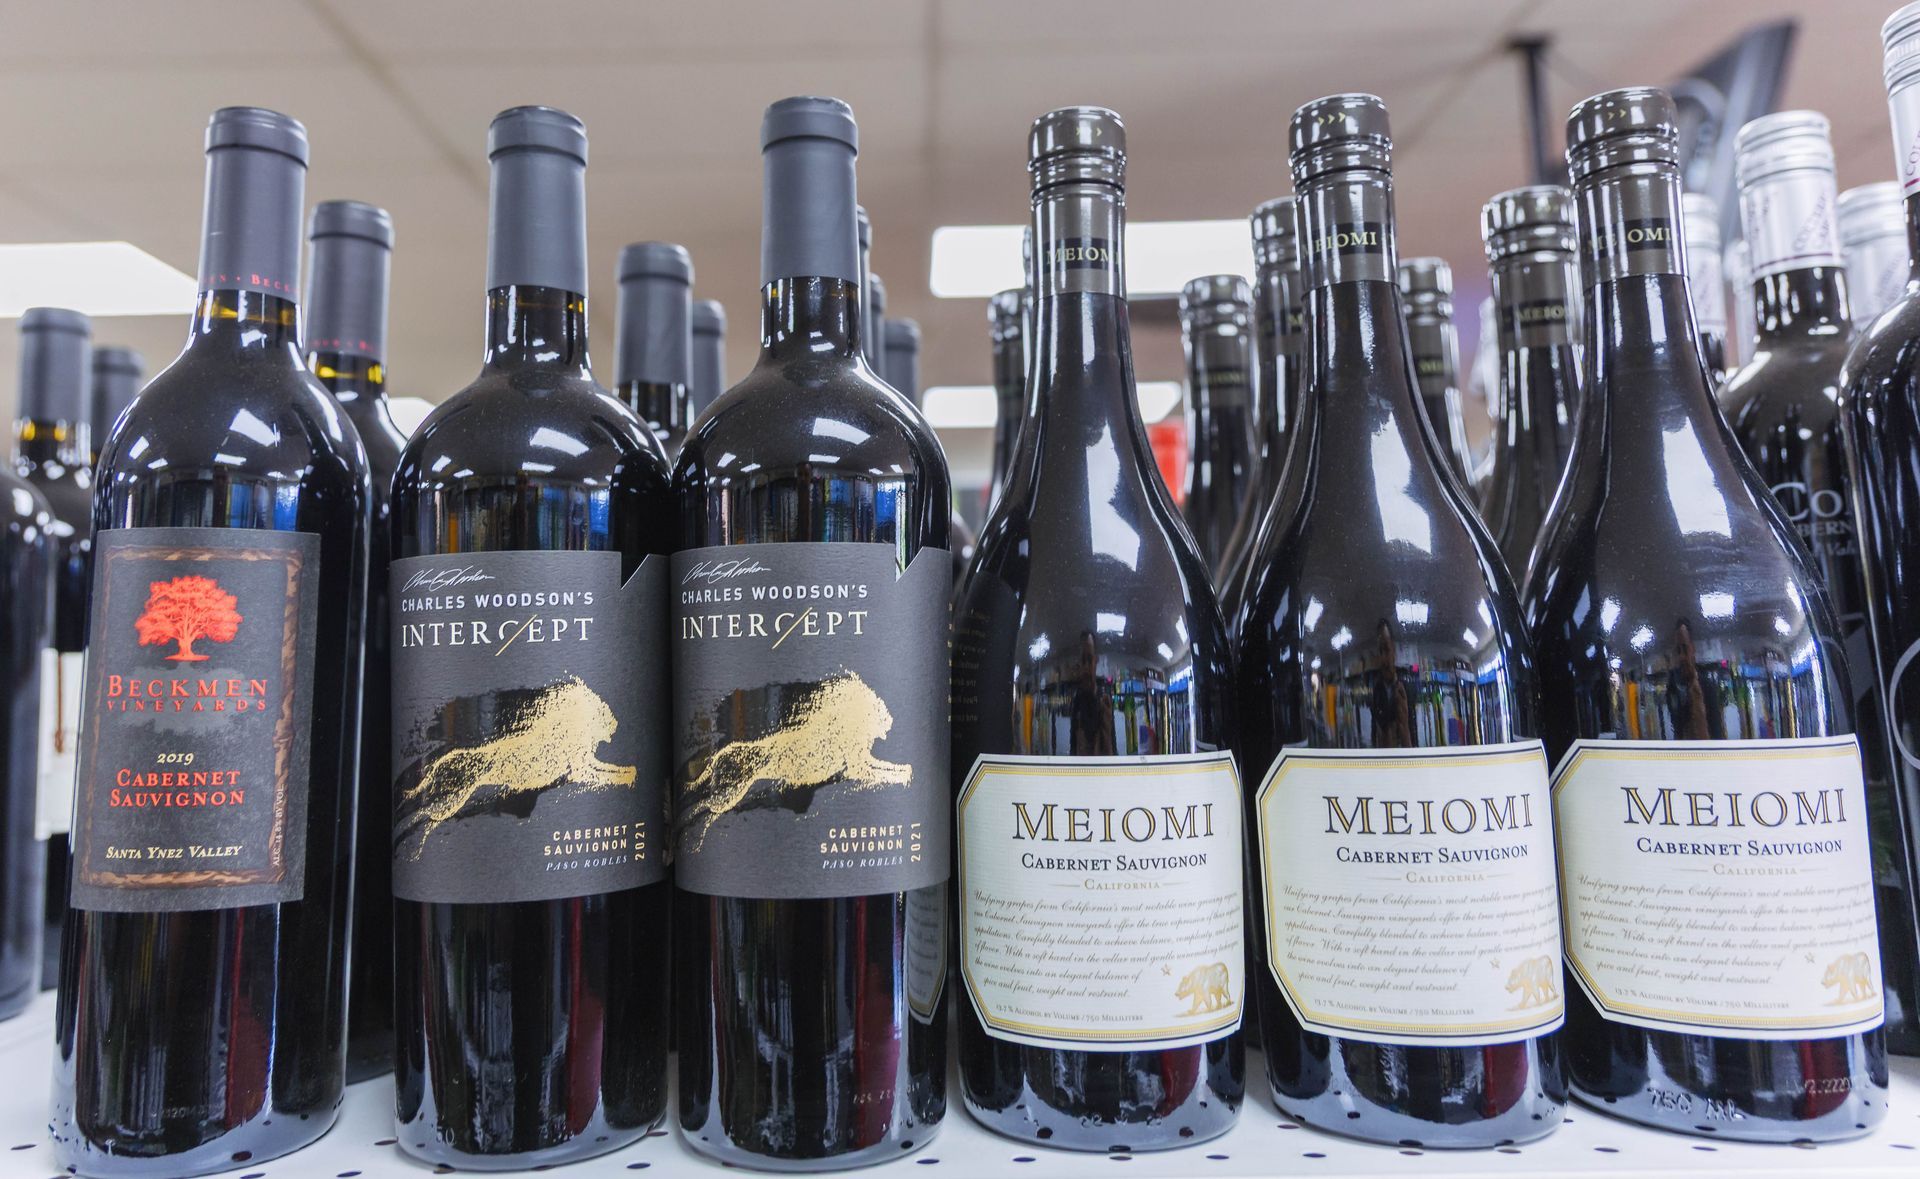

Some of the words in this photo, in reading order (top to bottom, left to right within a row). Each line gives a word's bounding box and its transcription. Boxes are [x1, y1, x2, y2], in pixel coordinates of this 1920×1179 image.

[402, 596, 465, 612] CHARLES
[475, 591, 594, 608] WOODSON'S
[682, 587, 743, 604] CHARLES
[752, 584, 868, 599] WOODSON'S
[402, 614, 594, 651] INTERCEPT
[682, 609, 868, 643] INTERCEPT
[107, 674, 268, 698] BECKMEN
[107, 700, 267, 712] VINEYARDS
[157, 752, 194, 765] 2019
[117, 768, 241, 788] CABERNET
[110, 788, 245, 808] SAUVIGNON
[1322, 793, 1533, 836] MEIOMI
[1621, 787, 1847, 828] MEIOMI
[1012, 802, 1214, 843] MEIOMI
[553, 825, 628, 842] CABERNET
[829, 825, 903, 839] CABERNET
[544, 838, 628, 857] SAUVIGNON
[635, 822, 646, 861] 2021
[820, 838, 903, 854] SAUVIGNON
[910, 822, 921, 862] 2021
[1637, 837, 1741, 857] CABERNET
[1748, 839, 1843, 857] SAUVIGNON
[105, 846, 142, 860] SANTA
[148, 846, 183, 860] YNEZ
[188, 845, 244, 859] VALLEY
[1337, 847, 1433, 865] CABERNET
[1439, 844, 1528, 864] SAUVIGNON
[546, 858, 579, 872] PASO
[584, 855, 628, 869] ROBLES
[822, 858, 855, 870] PASO
[860, 855, 904, 869] ROBLES
[1022, 852, 1111, 872] CABERNET
[1116, 852, 1207, 872] SAUVIGNON
[1713, 864, 1797, 876] CALIFORNIA
[1084, 878, 1160, 890] CALIFORNIA
[1406, 871, 1484, 883] CALIFORNIA
[1622, 884, 1655, 895] grapes
[1656, 884, 1683, 897] from
[1034, 899, 1058, 912] from
[1061, 899, 1118, 916] California's
[1121, 903, 1144, 912] most
[1321, 894, 1352, 906] grapes
[1353, 893, 1378, 907] from
[1057, 934, 1093, 945] blended
[1048, 951, 1074, 962] hand
[1087, 953, 1099, 962] the
[1130, 952, 1150, 963] and
[1058, 968, 1094, 983] elegant
[1094, 969, 1130, 981] balance
